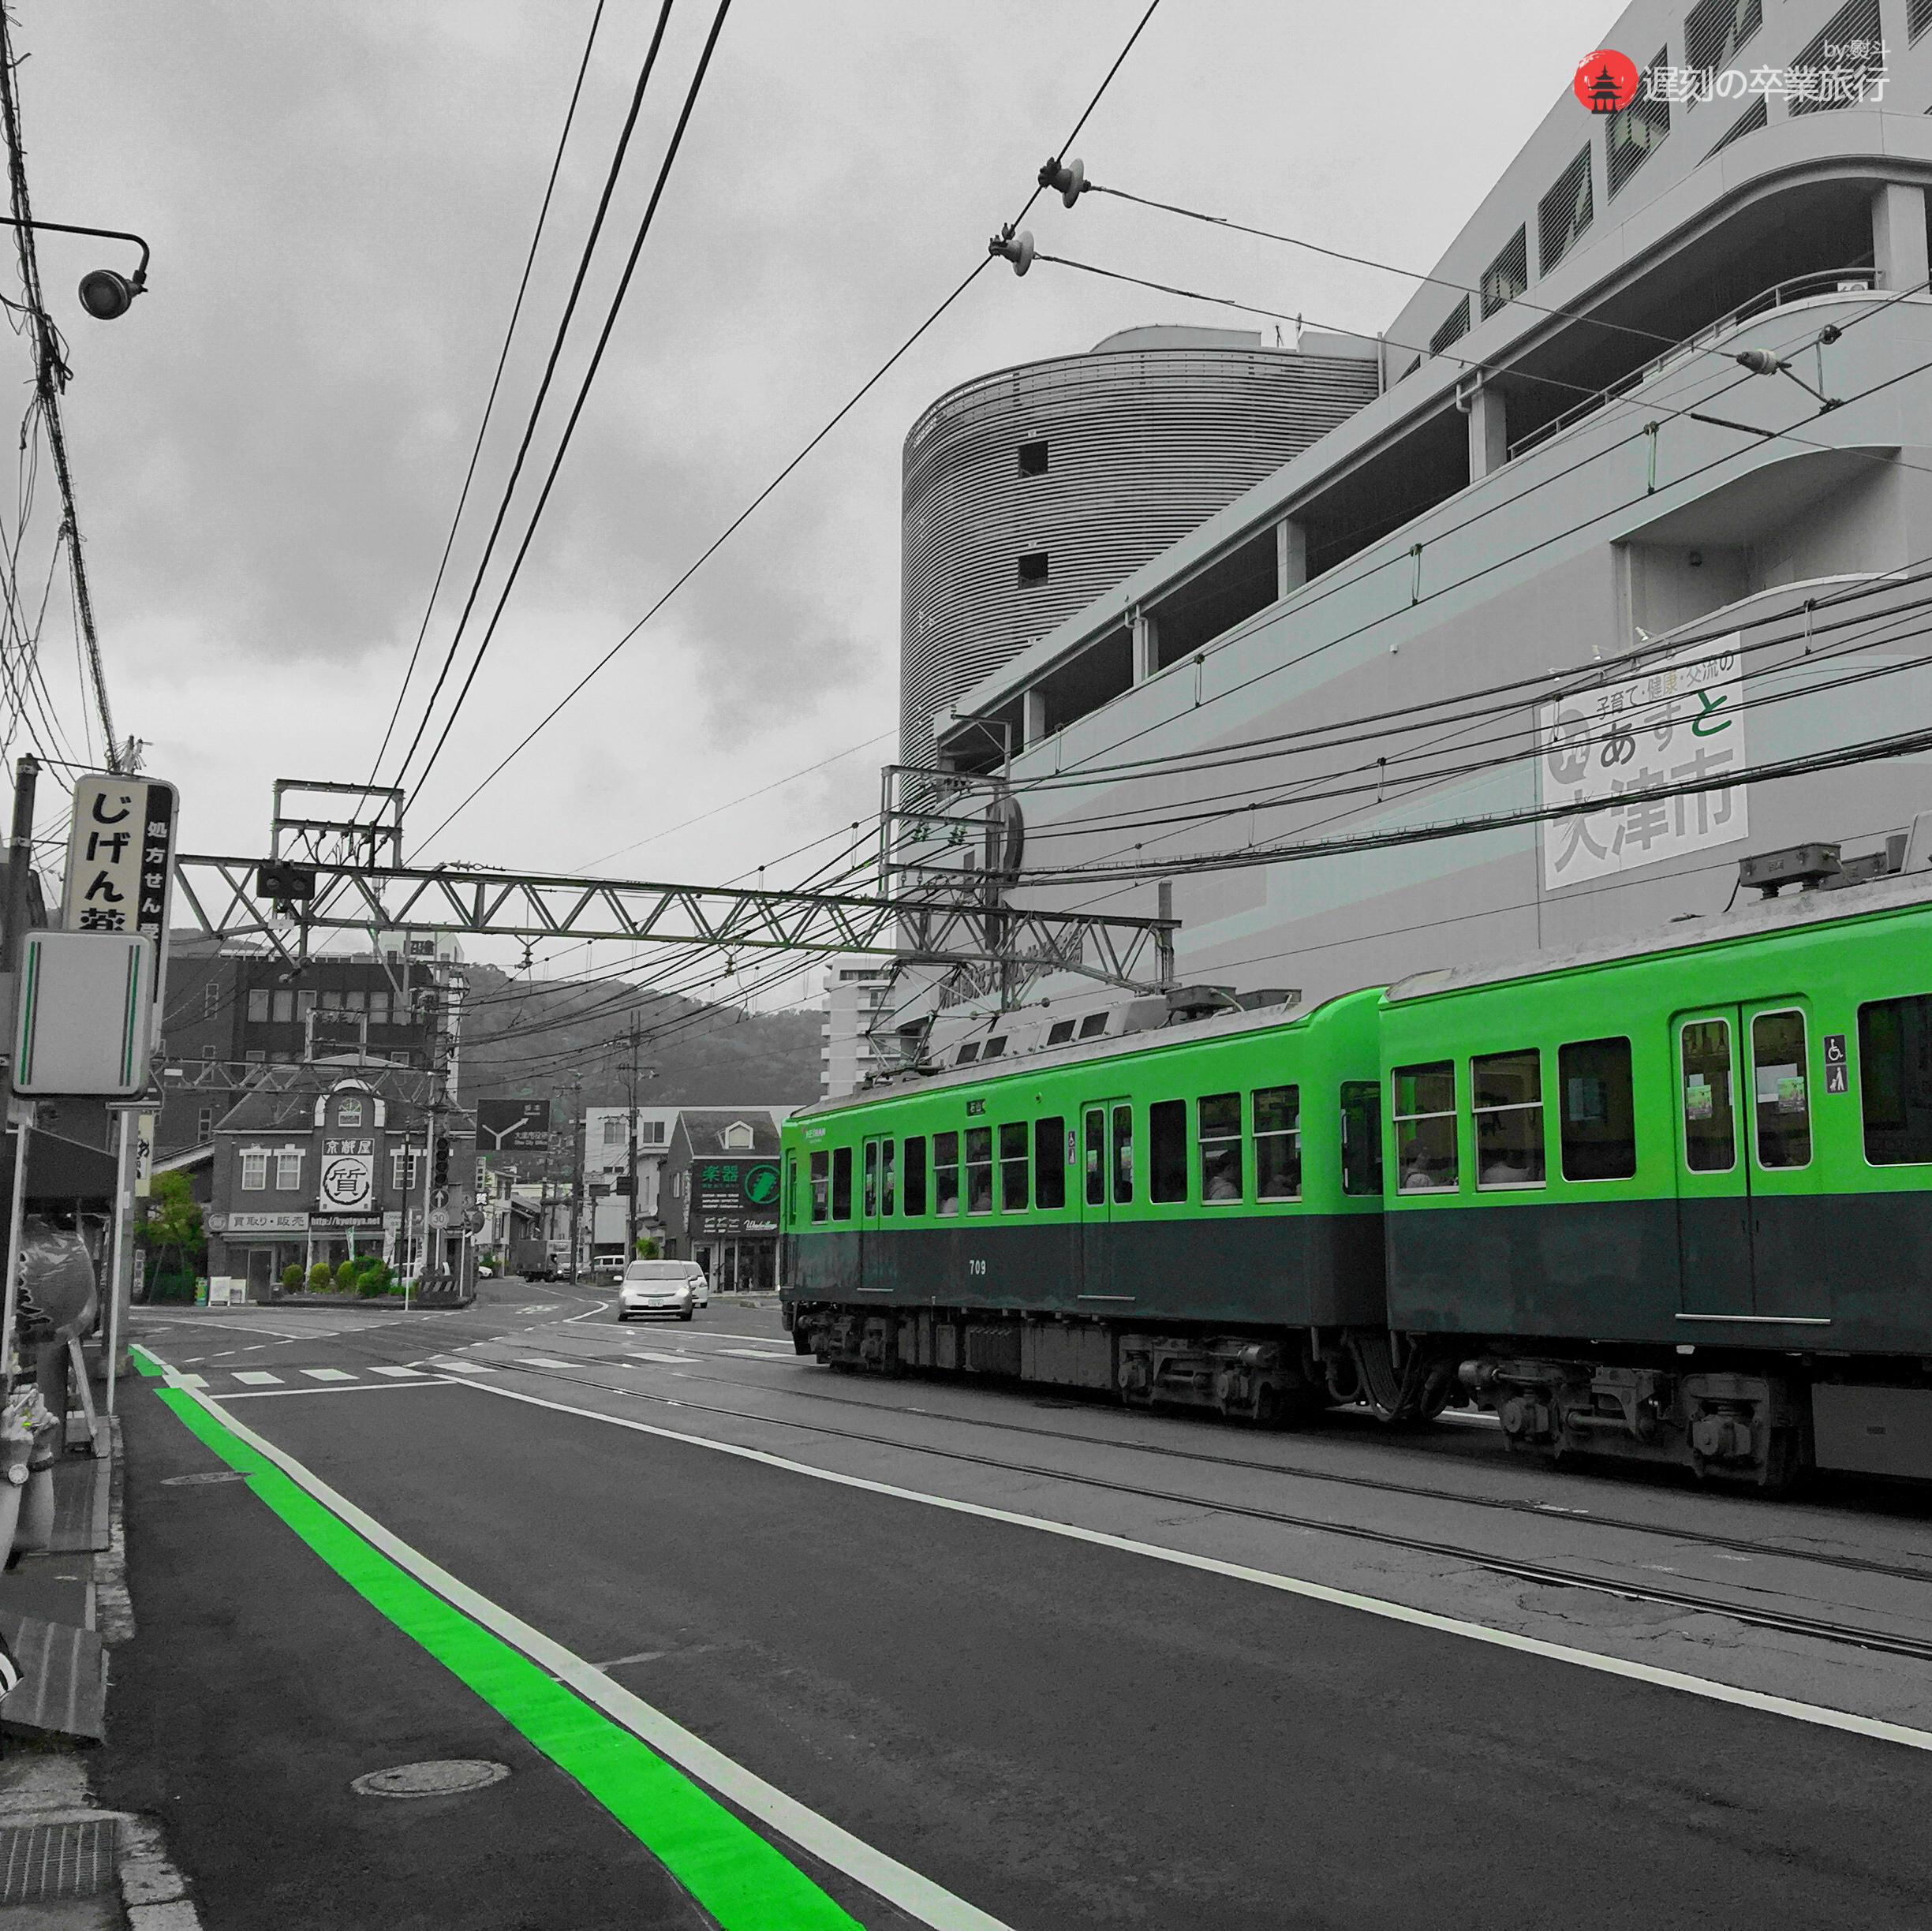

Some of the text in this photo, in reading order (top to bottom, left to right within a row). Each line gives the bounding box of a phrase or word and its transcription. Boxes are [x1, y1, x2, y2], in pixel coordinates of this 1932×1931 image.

[1553, 748, 1734, 872] 大津市
[326, 1140, 372, 1155] 京都屋
[702, 1165, 738, 1182] 楽器
[329, 1168, 367, 1197] 質
[433, 1215, 445, 1223] 30
[970, 1259, 986, 1275] 709
